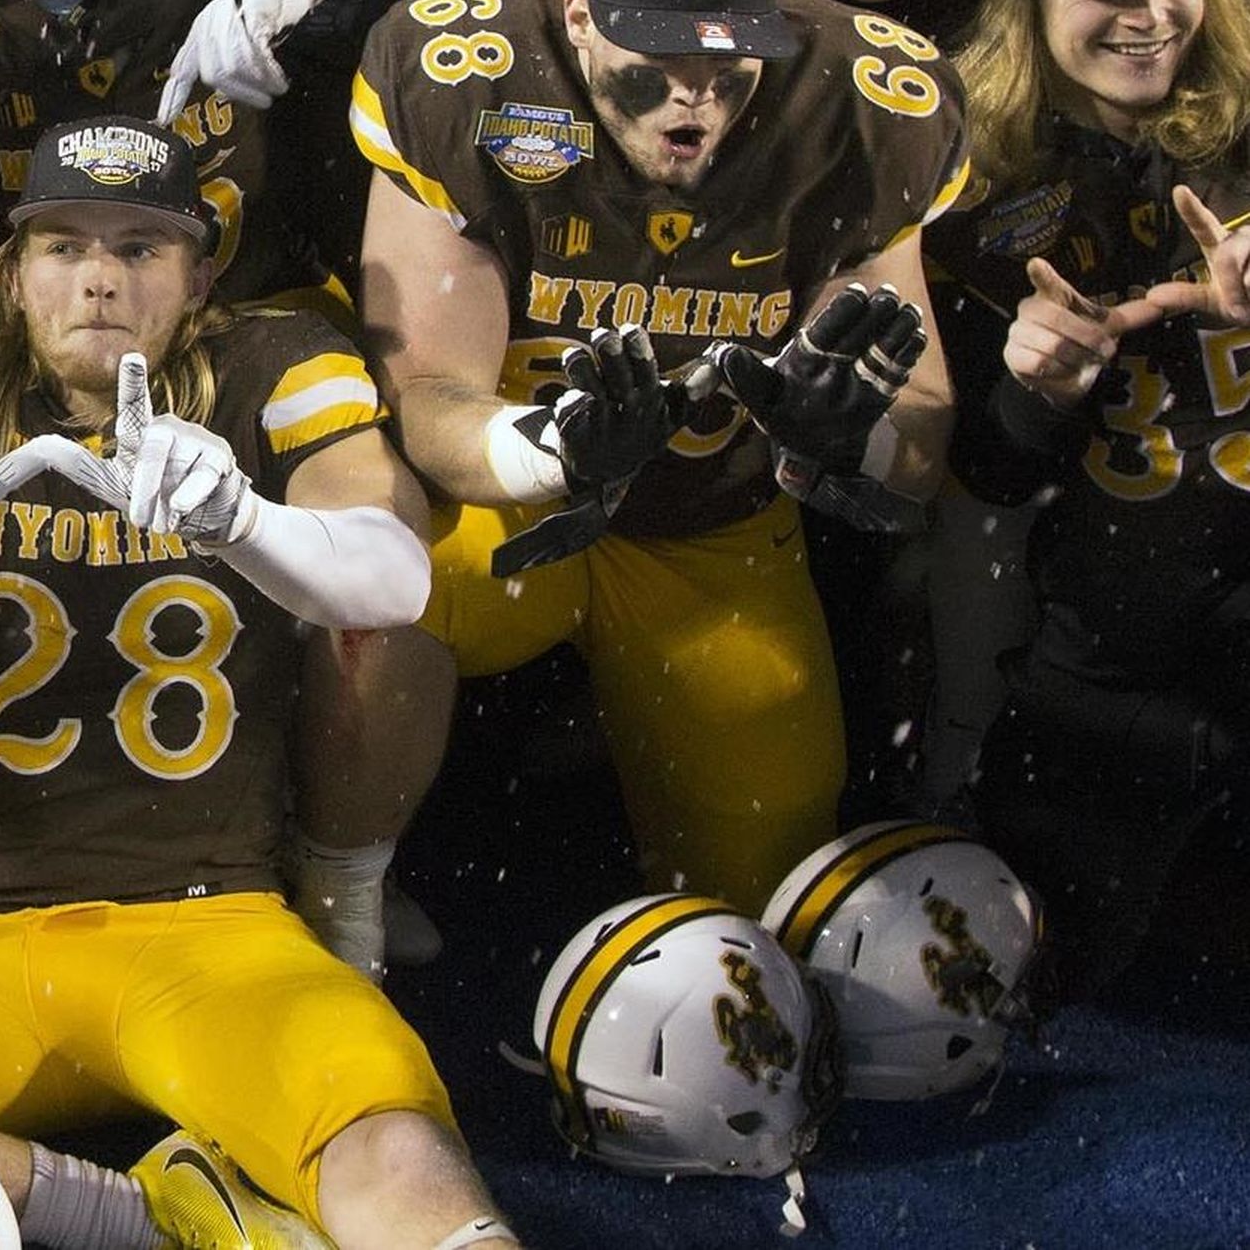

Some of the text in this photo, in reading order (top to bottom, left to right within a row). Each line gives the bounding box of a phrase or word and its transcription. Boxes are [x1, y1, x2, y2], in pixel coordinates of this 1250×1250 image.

[507, 106, 567, 122] FAMOUS
[58, 126, 169, 165] CHAMPIONS
[503, 151, 559, 168] BOWL
[527, 270, 793, 338] WYOMING
